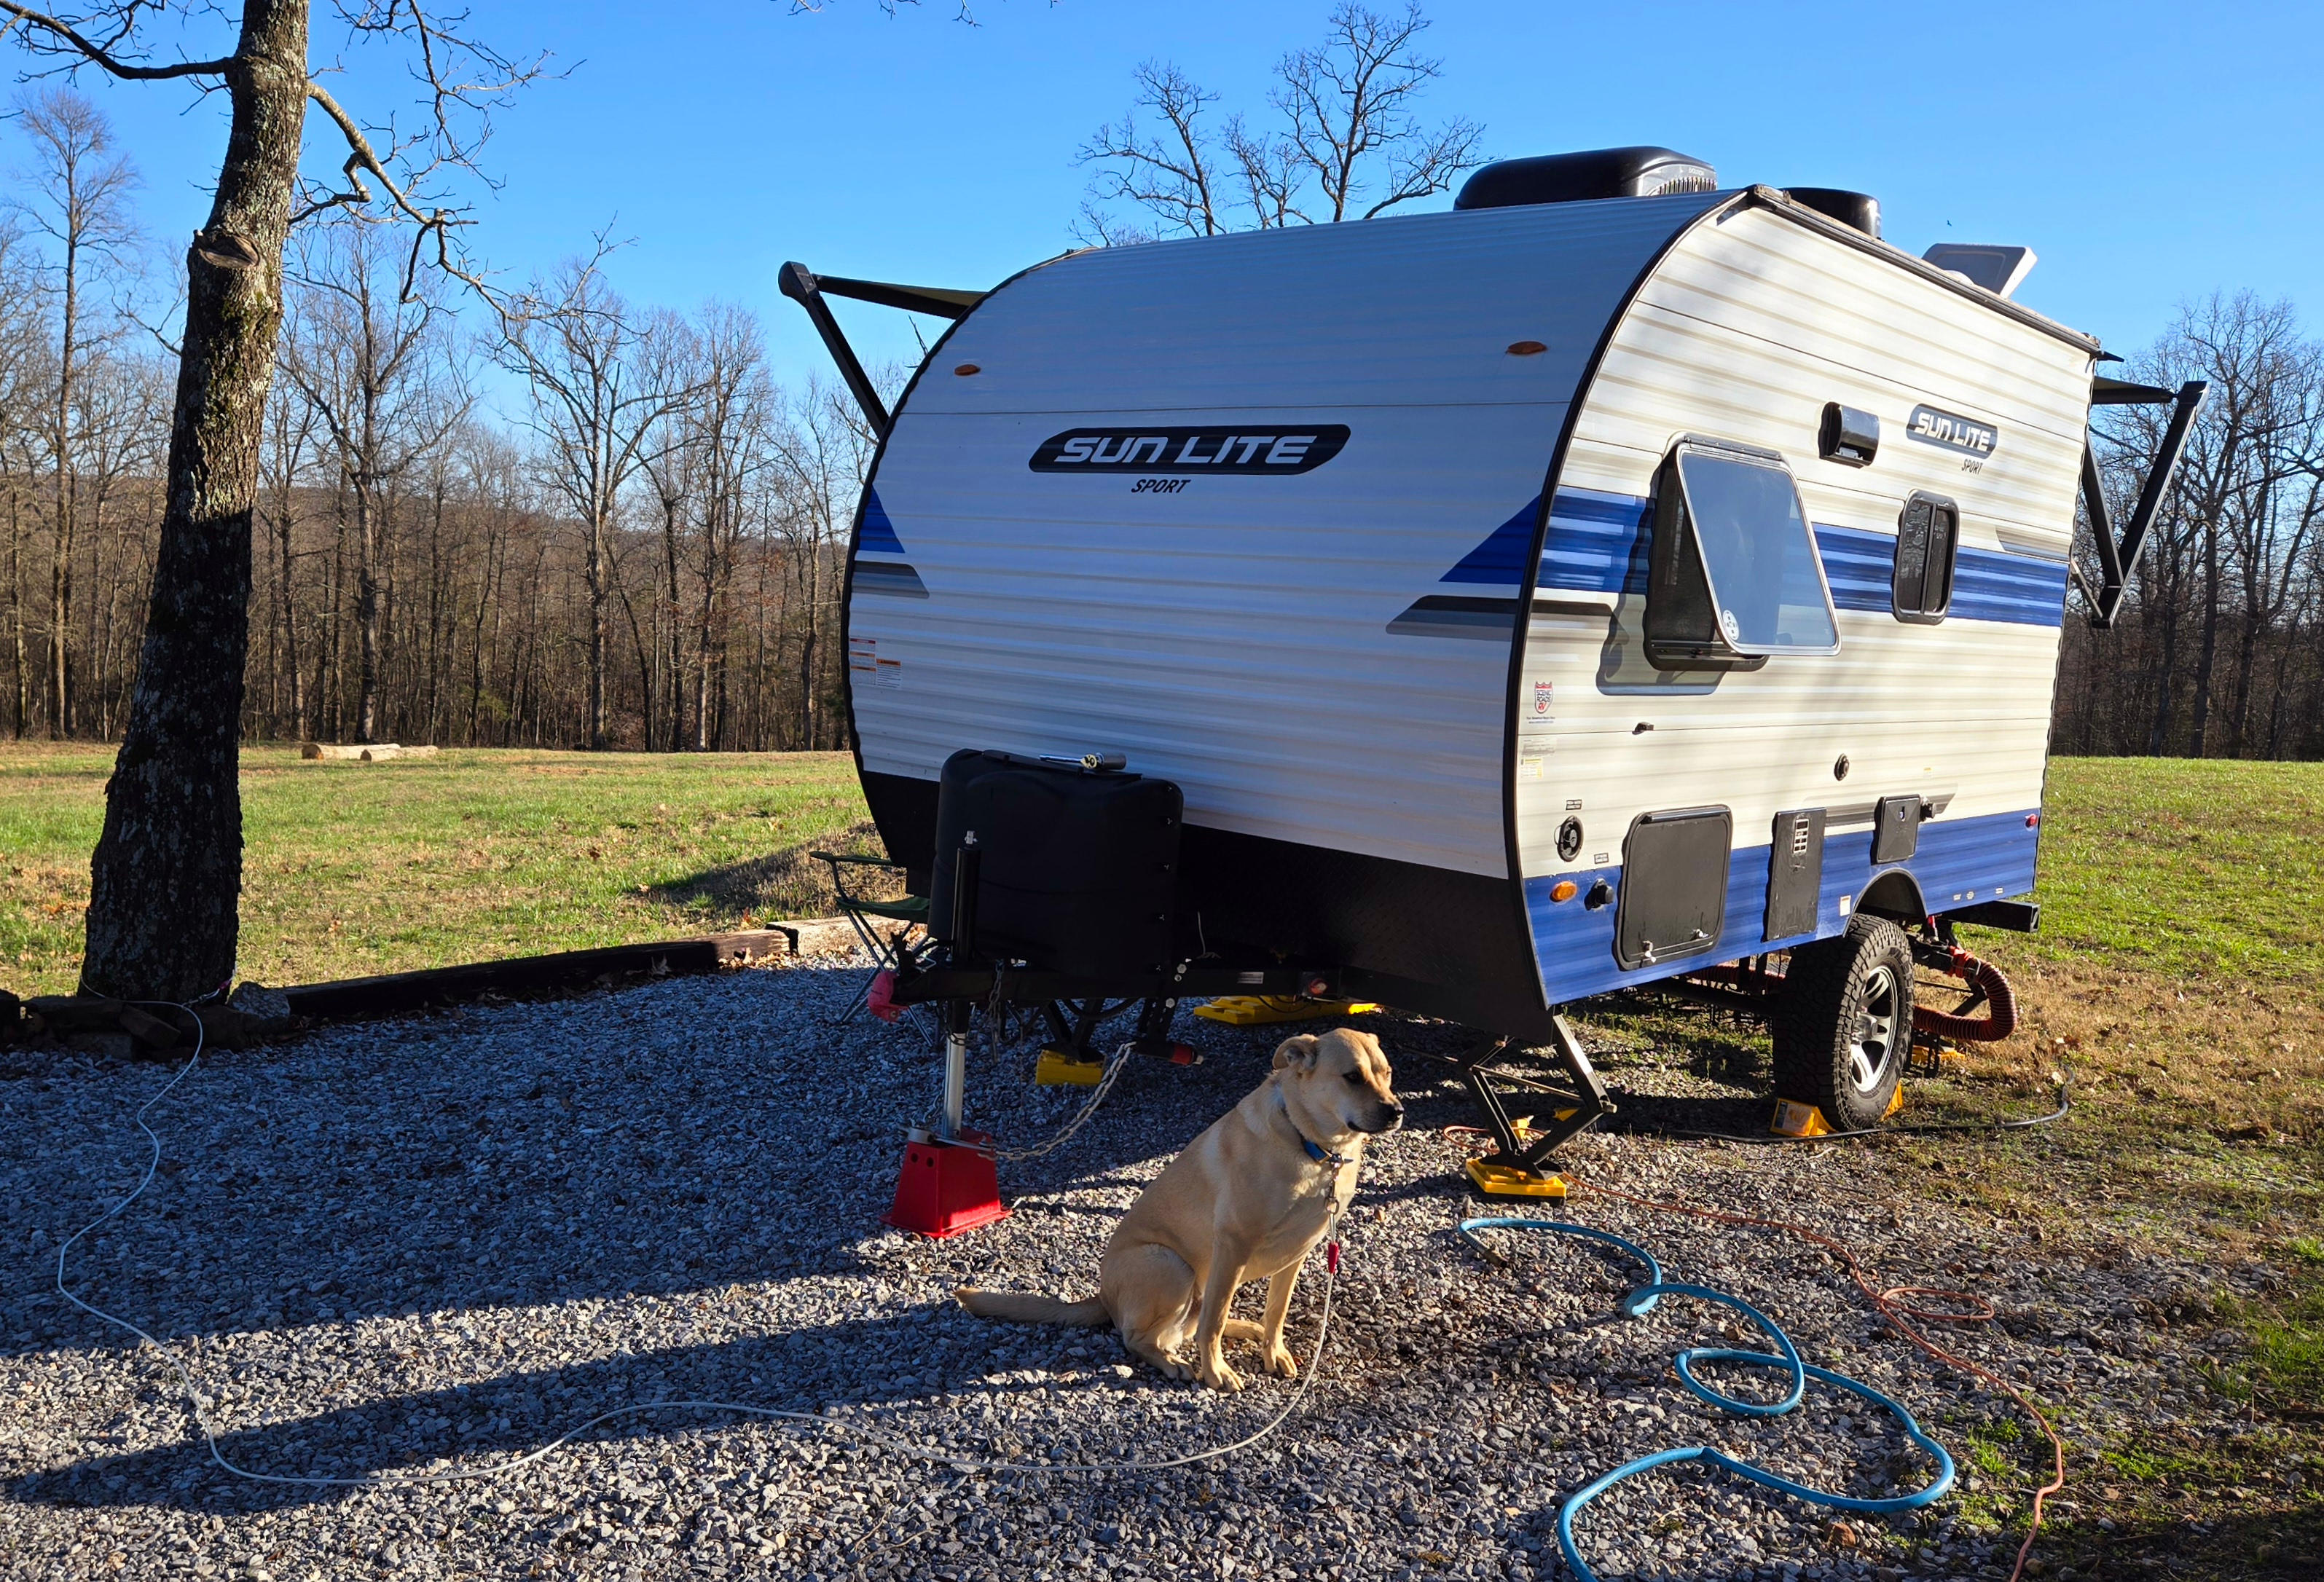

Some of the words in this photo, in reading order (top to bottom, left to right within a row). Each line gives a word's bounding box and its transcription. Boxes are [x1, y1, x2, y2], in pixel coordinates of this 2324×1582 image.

[1914, 412, 1952, 441] SUN
[1953, 422, 1991, 452] LITE
[1054, 436, 1169, 463] SUN
[1174, 436, 1318, 464] LITE
[1962, 459, 1982, 474] SPORT
[1131, 478, 1191, 494] SPORT
